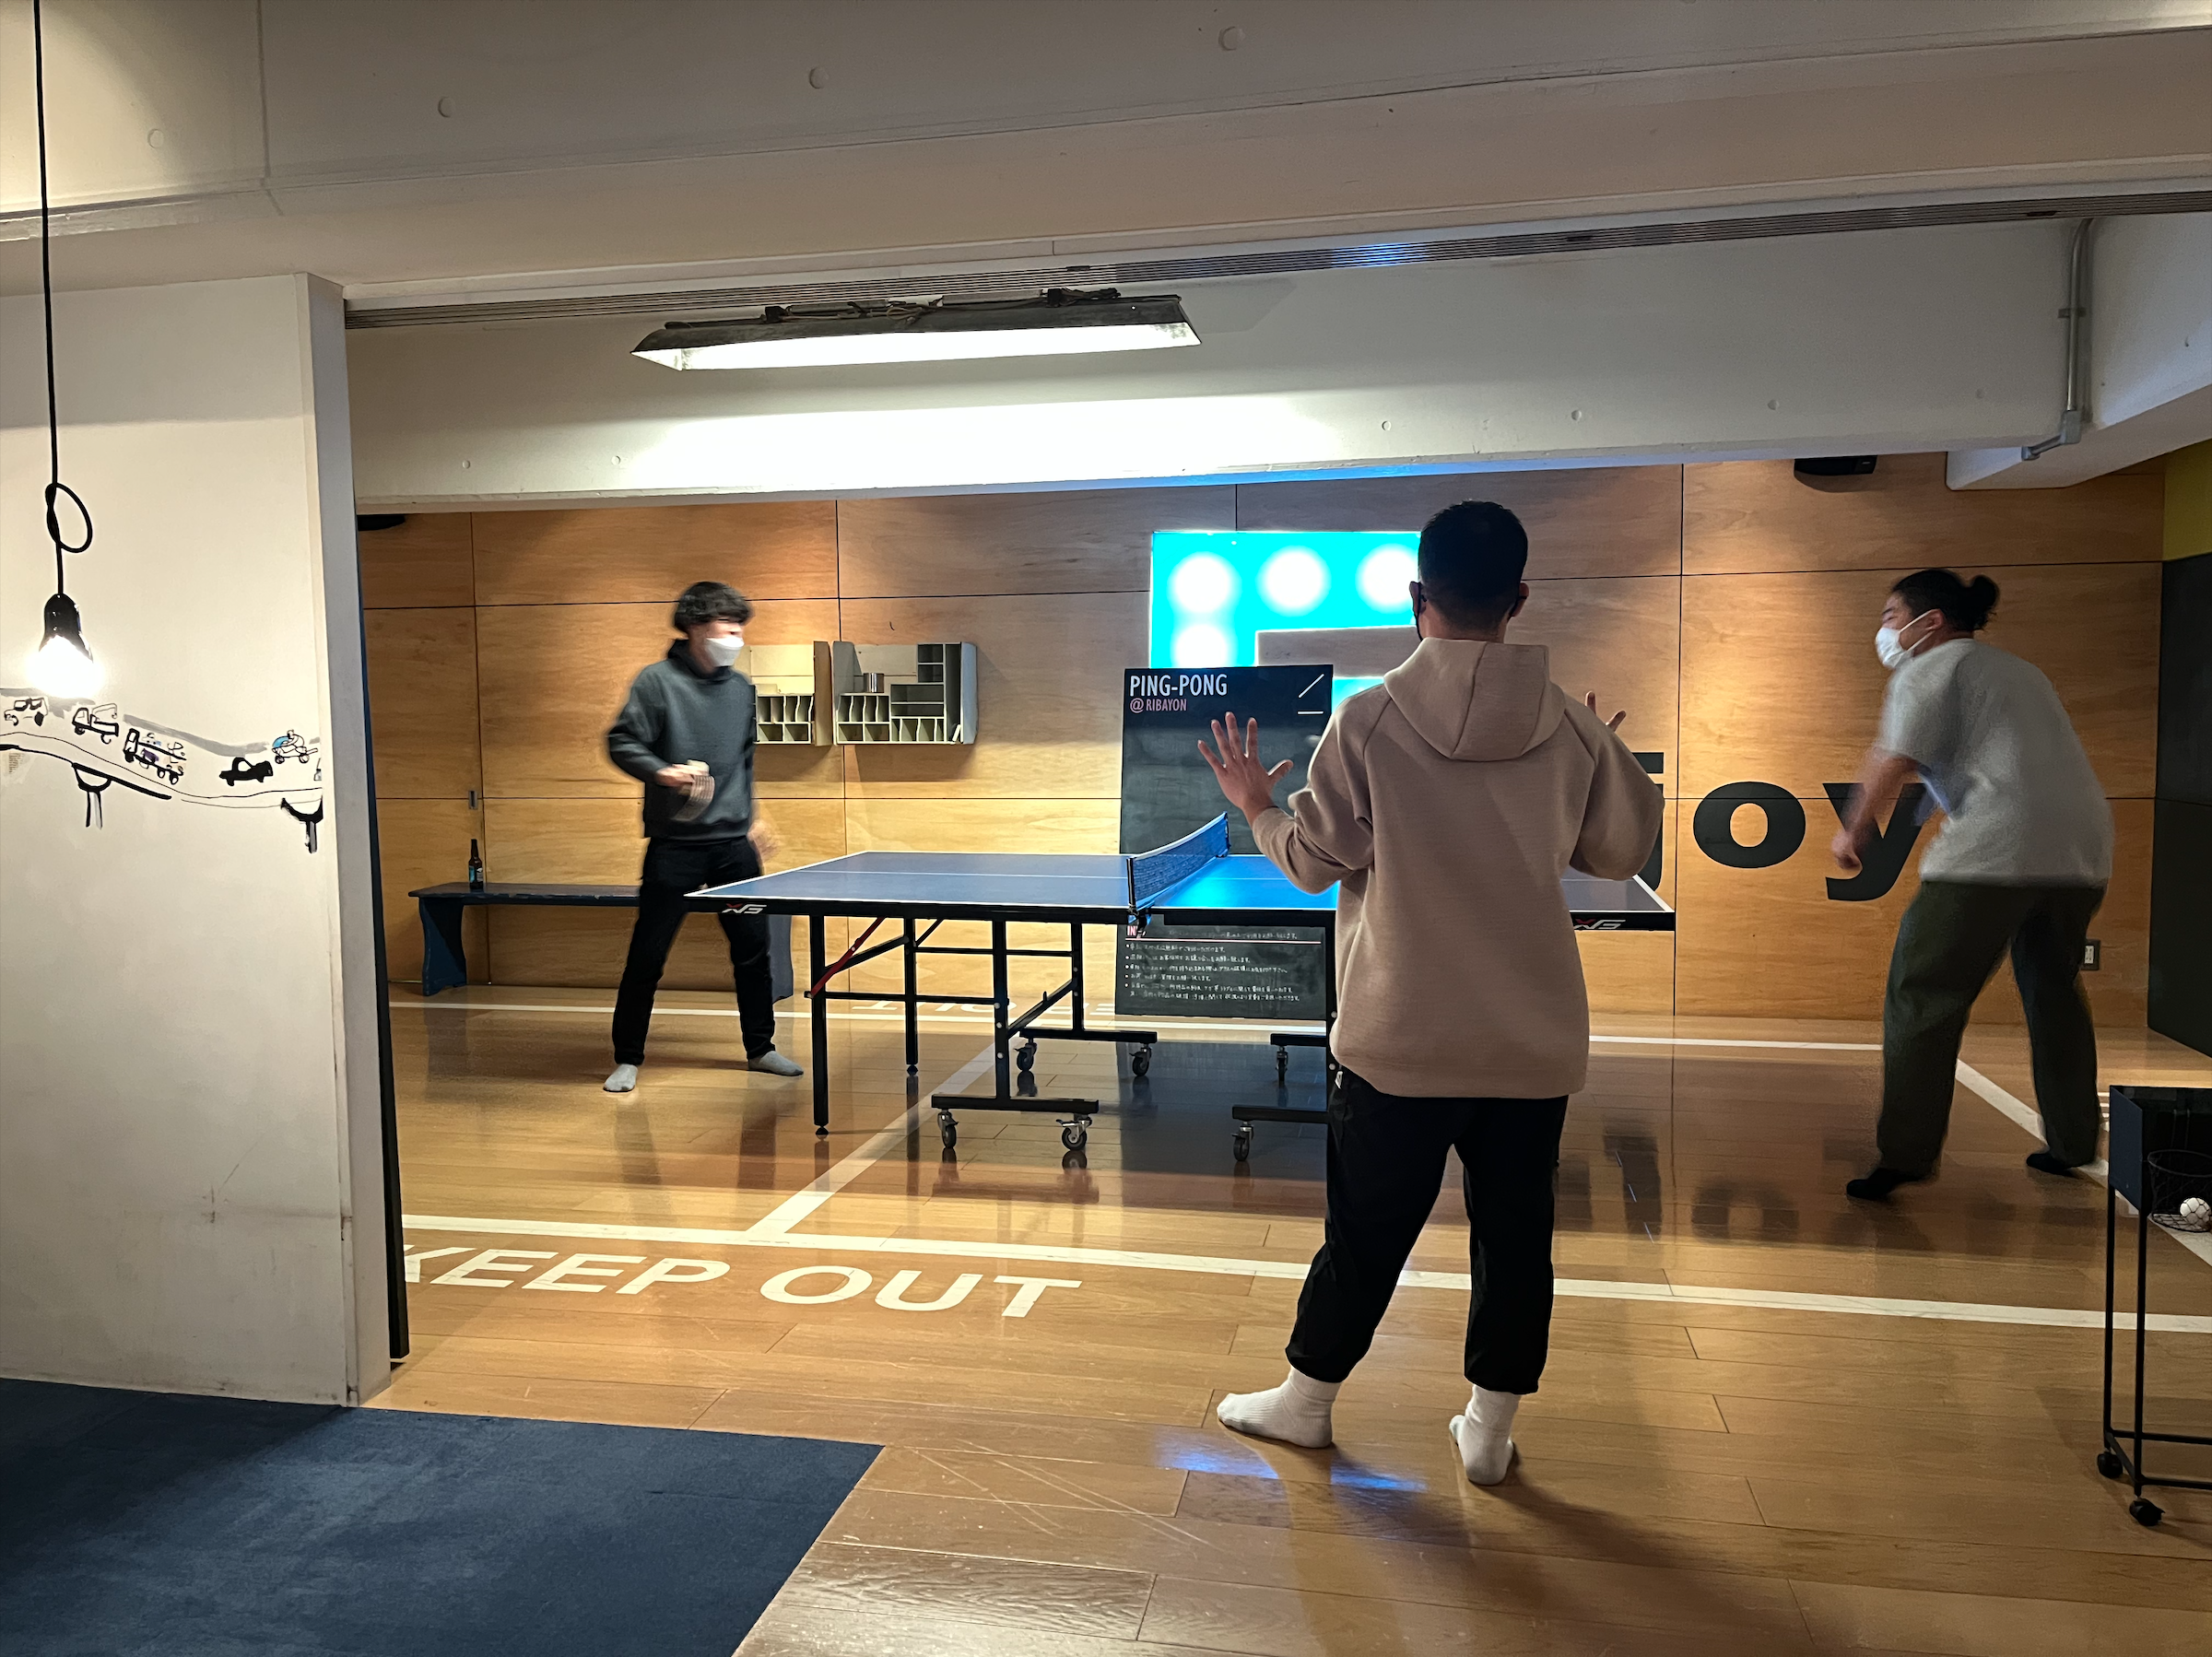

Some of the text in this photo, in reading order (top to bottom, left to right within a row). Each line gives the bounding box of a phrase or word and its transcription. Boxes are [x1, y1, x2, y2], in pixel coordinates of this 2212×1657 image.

[1130, 674, 1228, 697] PING-PONG
[1146, 699, 1187, 711] RIBAYON
[405, 1244, 1083, 1318] KEEP OUT
